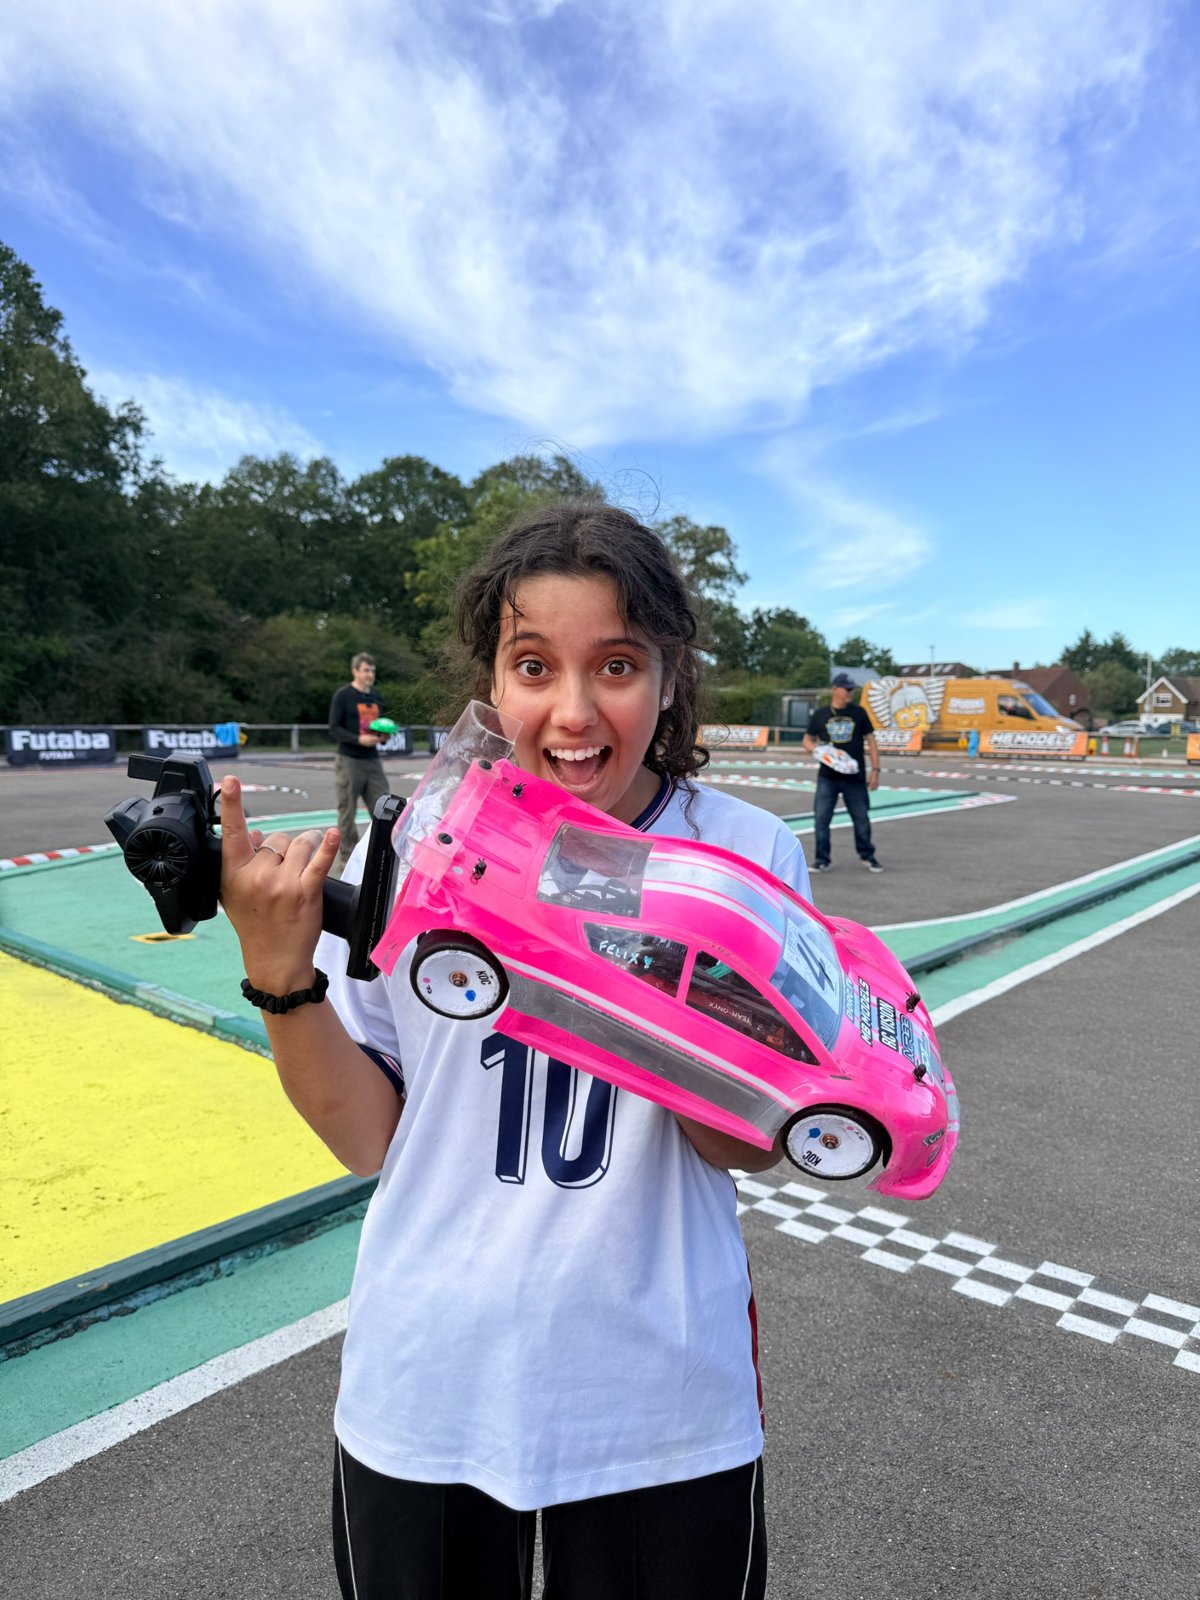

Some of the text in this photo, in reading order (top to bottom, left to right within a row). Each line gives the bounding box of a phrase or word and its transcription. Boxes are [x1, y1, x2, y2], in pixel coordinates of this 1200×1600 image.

[11, 730, 110, 751] Futaba
[148, 730, 224, 749] Futab
[599, 940, 640, 965] FELIX
[476, 970, 492, 985] KOC
[708, 1001, 751, 1024] TEAM-ONYX
[859, 977, 872, 1047] MB MODELS
[879, 999, 898, 1052] RC VISION
[481, 1032, 618, 1190] 10
[803, 1150, 822, 1167] KOC
